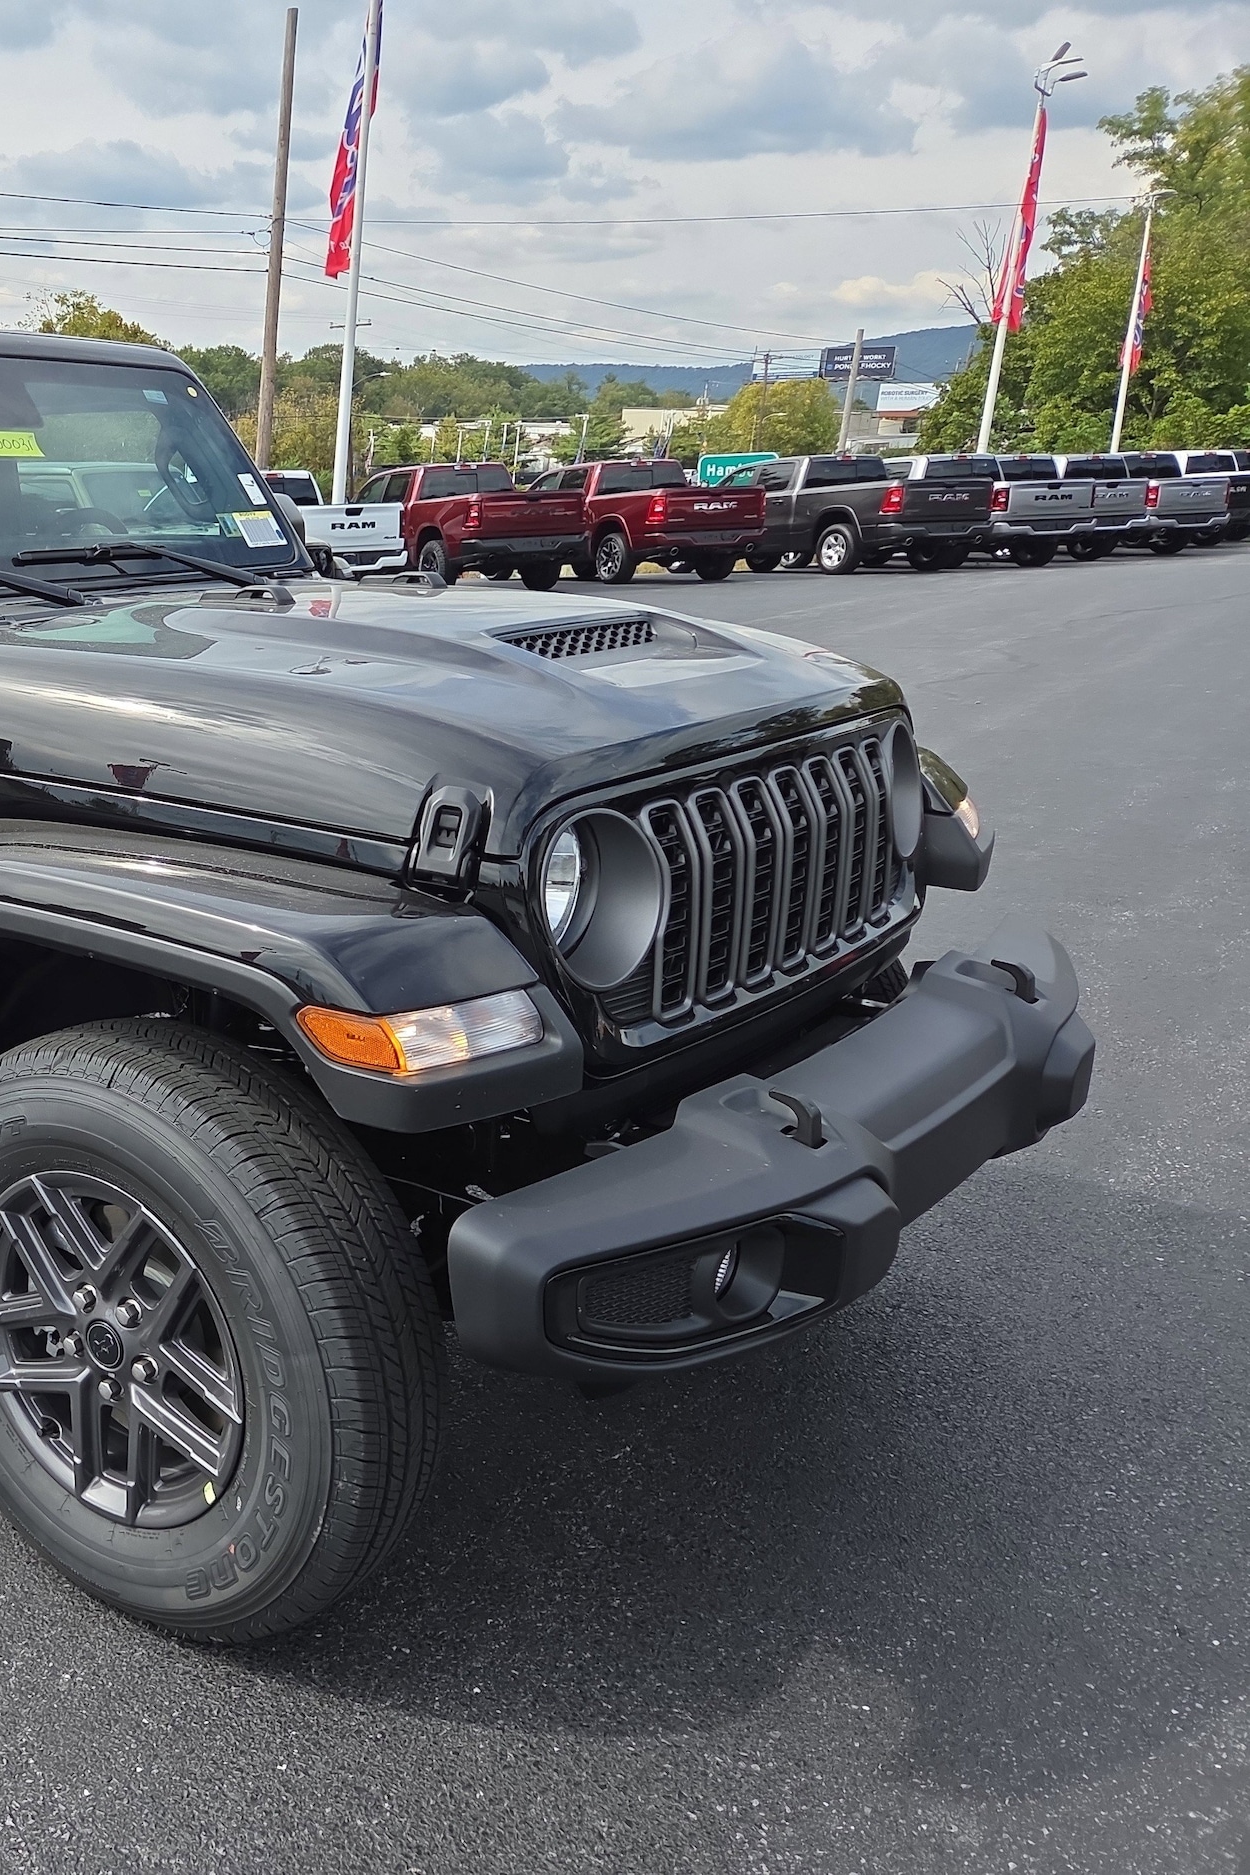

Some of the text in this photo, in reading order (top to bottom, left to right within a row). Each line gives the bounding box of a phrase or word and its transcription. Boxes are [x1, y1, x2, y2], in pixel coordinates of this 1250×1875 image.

[928, 493, 970, 501] RAM
[694, 502, 738, 510] RAM
[331, 521, 376, 530] RAM
